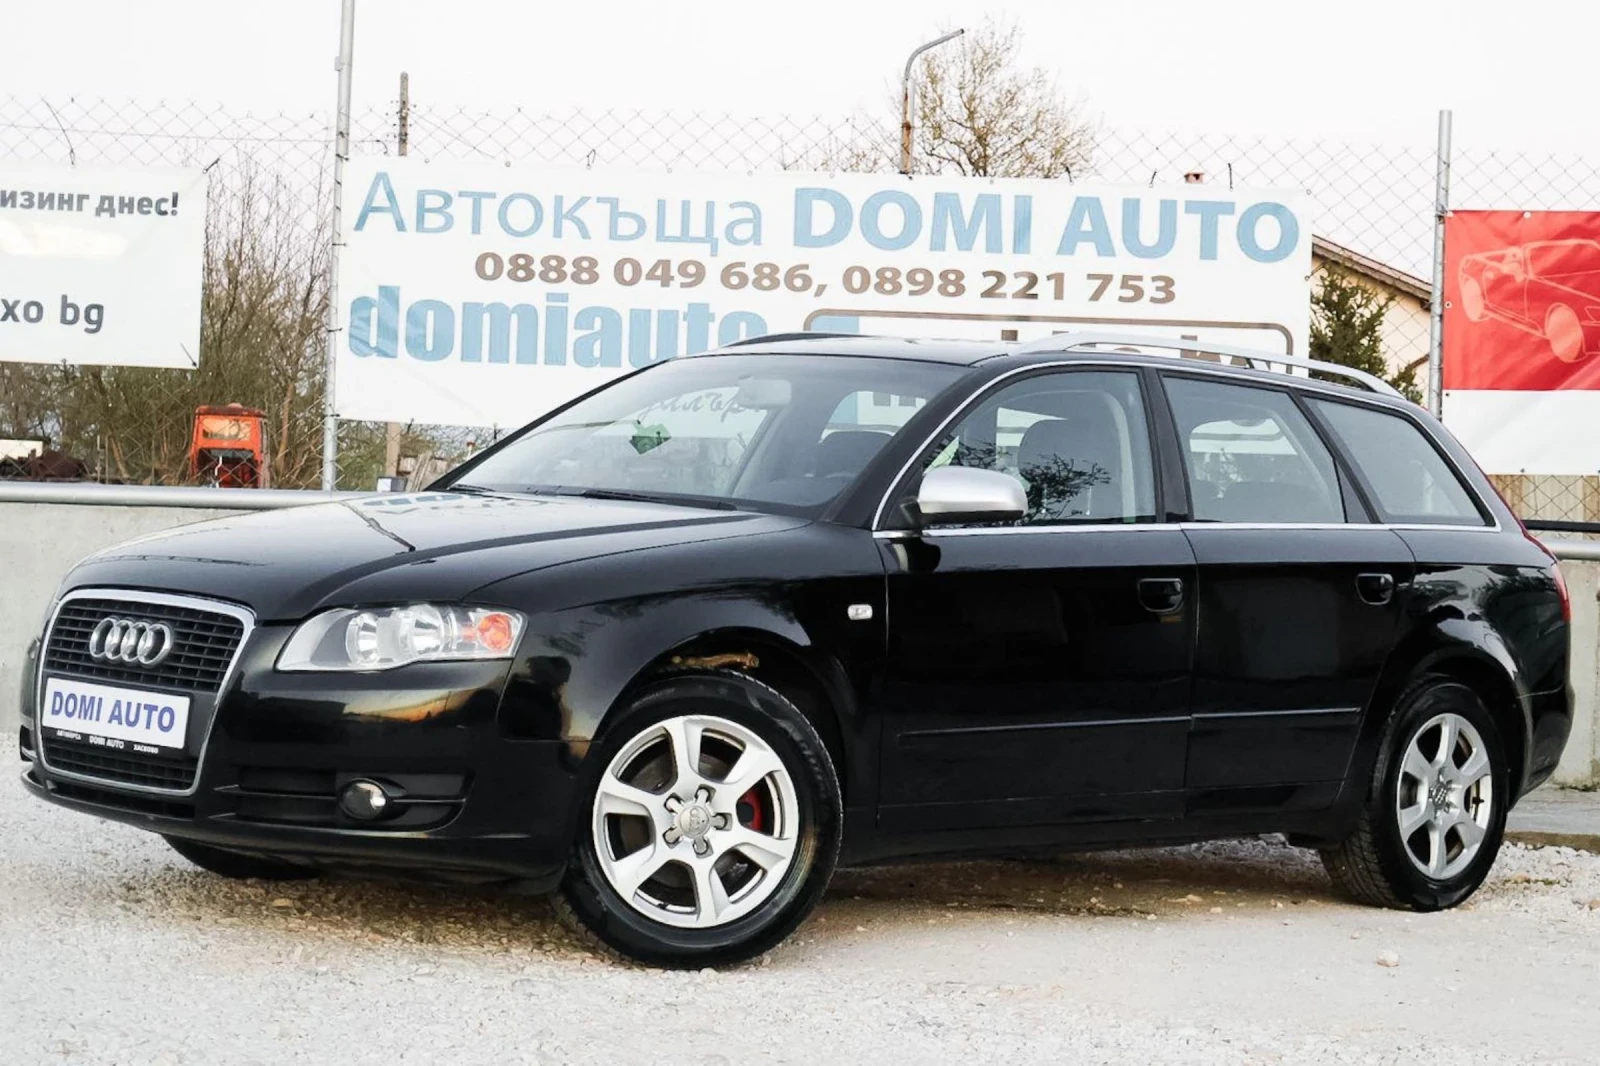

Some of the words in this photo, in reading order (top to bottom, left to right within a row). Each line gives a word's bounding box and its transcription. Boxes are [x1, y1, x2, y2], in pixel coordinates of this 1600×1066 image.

[95, 191, 179, 217] днес!
[354, 172, 762, 256] Автокъща
[793, 187, 1032, 255] DOMI
[1056, 196, 1299, 264] AUTO
[475, 252, 600, 285] 0888
[613, 257, 706, 288] 049
[720, 261, 829, 298] 686,
[842, 264, 966, 298] 0898
[980, 270, 1066, 301] 221
[1086, 273, 1176, 304] 753
[59, 294, 105, 334] bg
[51, 691, 103, 722] DOMI
[107, 699, 176, 732] AUTO
[89, 735, 106, 746] DOMI
[106, 738, 125, 749] AUTO
